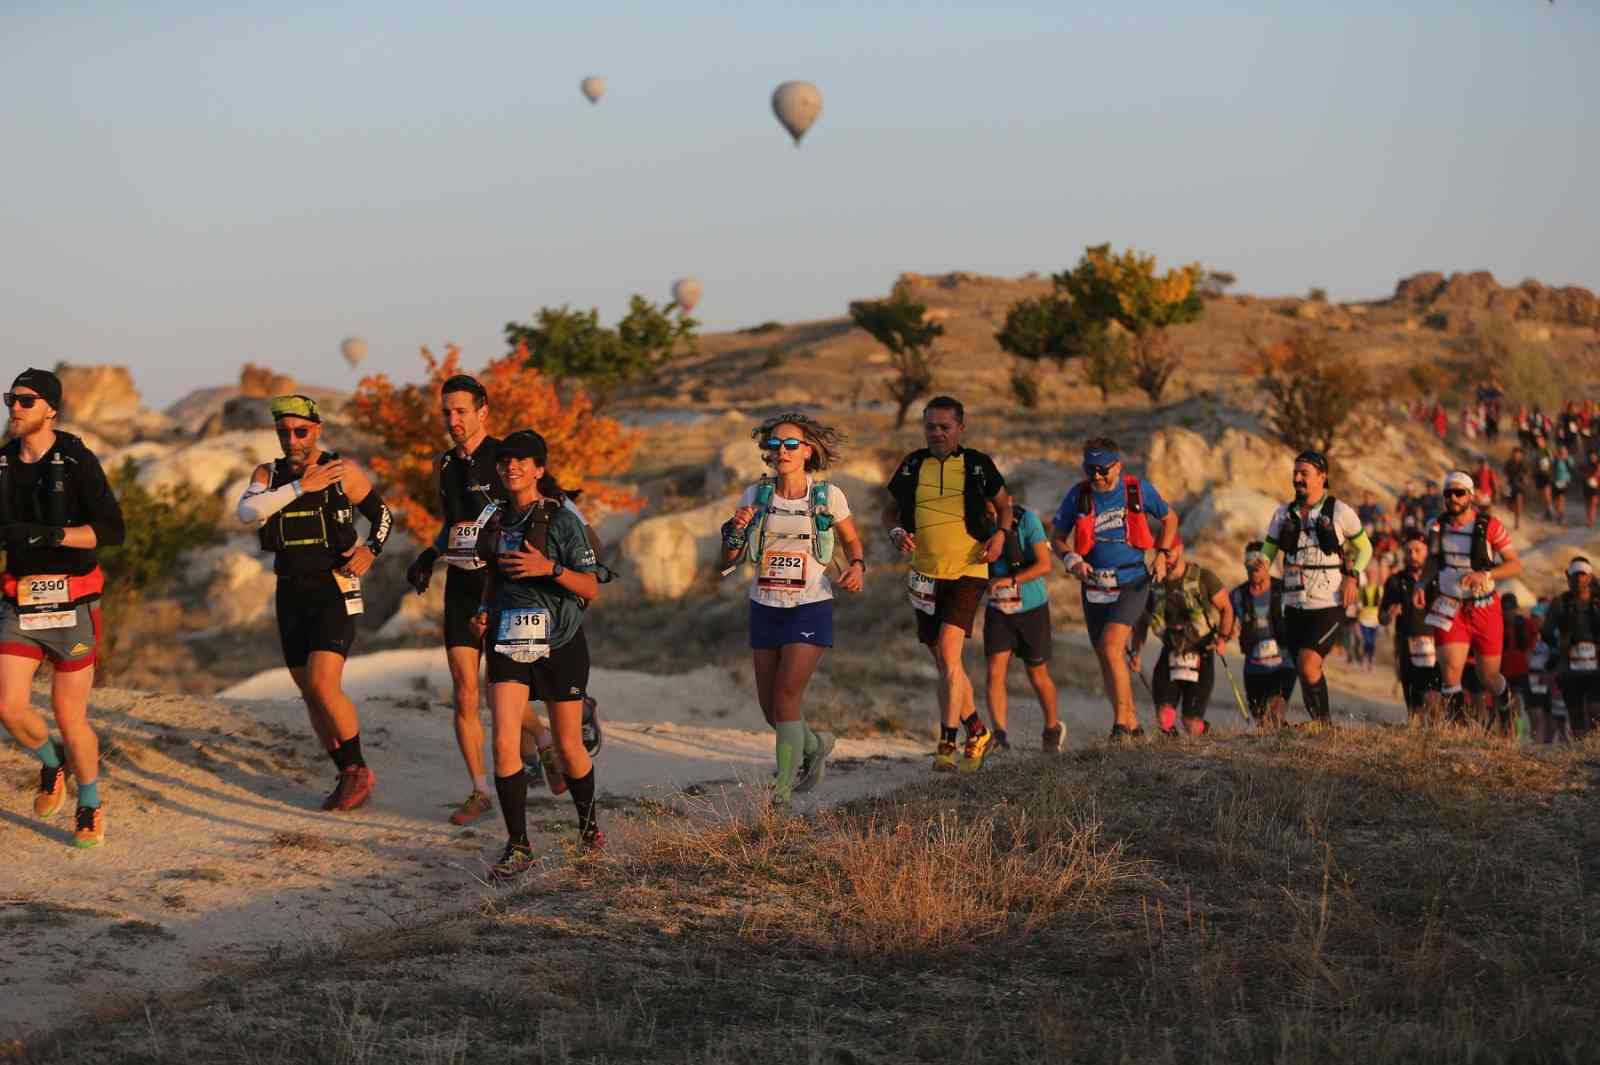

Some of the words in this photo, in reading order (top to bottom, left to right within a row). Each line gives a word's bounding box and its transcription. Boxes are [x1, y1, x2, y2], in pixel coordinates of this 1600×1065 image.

[770, 556, 801, 568] 2252
[31, 580, 65, 592] 2390
[514, 614, 540, 626] 316
